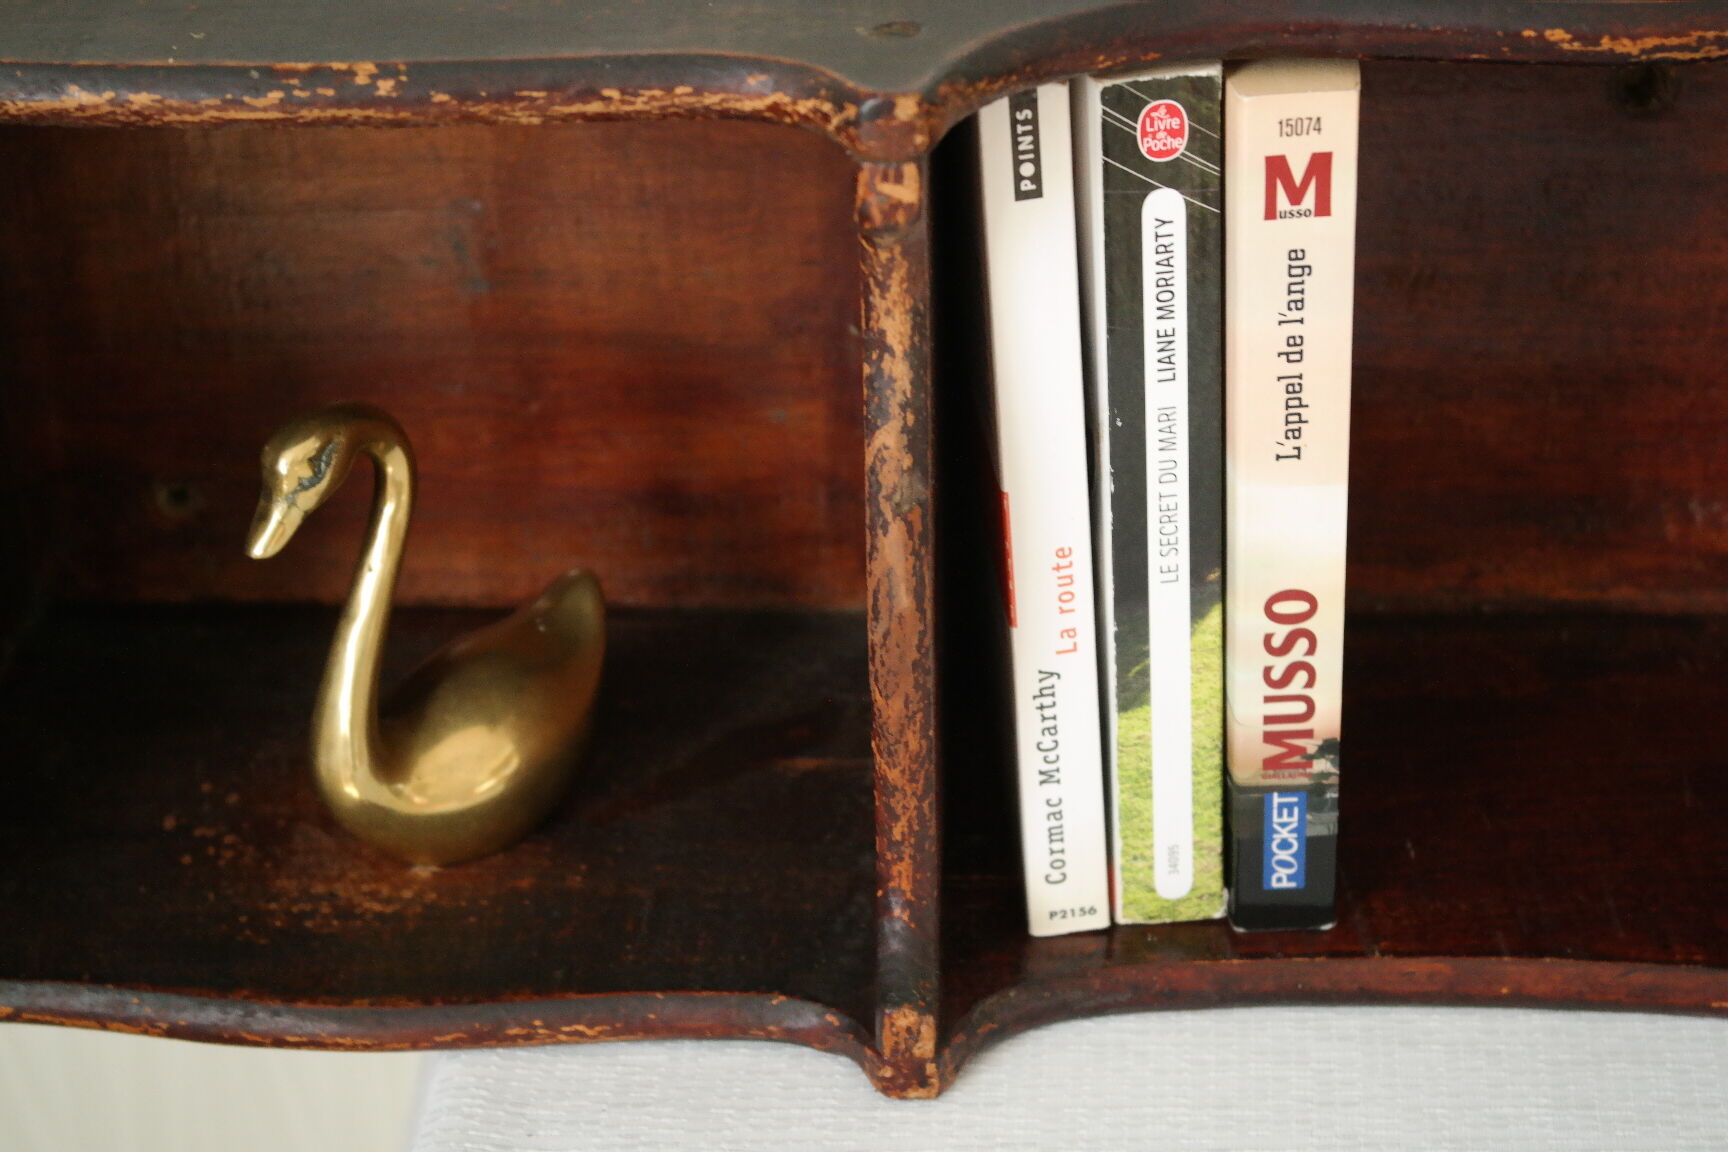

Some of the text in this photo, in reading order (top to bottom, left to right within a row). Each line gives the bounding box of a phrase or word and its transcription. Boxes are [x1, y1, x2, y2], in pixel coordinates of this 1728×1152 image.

[1016, 109, 1037, 191] POINTS
[1143, 135, 1183, 152] Poche
[1145, 117, 1181, 132] Livre
[1278, 117, 1322, 137] 15074
[1155, 217, 1176, 383] LIANE MORIARTY
[1276, 248, 1312, 462] L'appel de l'ange
[1157, 406, 1179, 584] LE SECRET DU MARI
[1052, 546, 1078, 655] La route
[1262, 589, 1318, 771] MUSSO
[1033, 669, 1067, 885] Cormac McCarthy
[1271, 791, 1299, 889] POCKET
[1050, 905, 1098, 921] P2156
